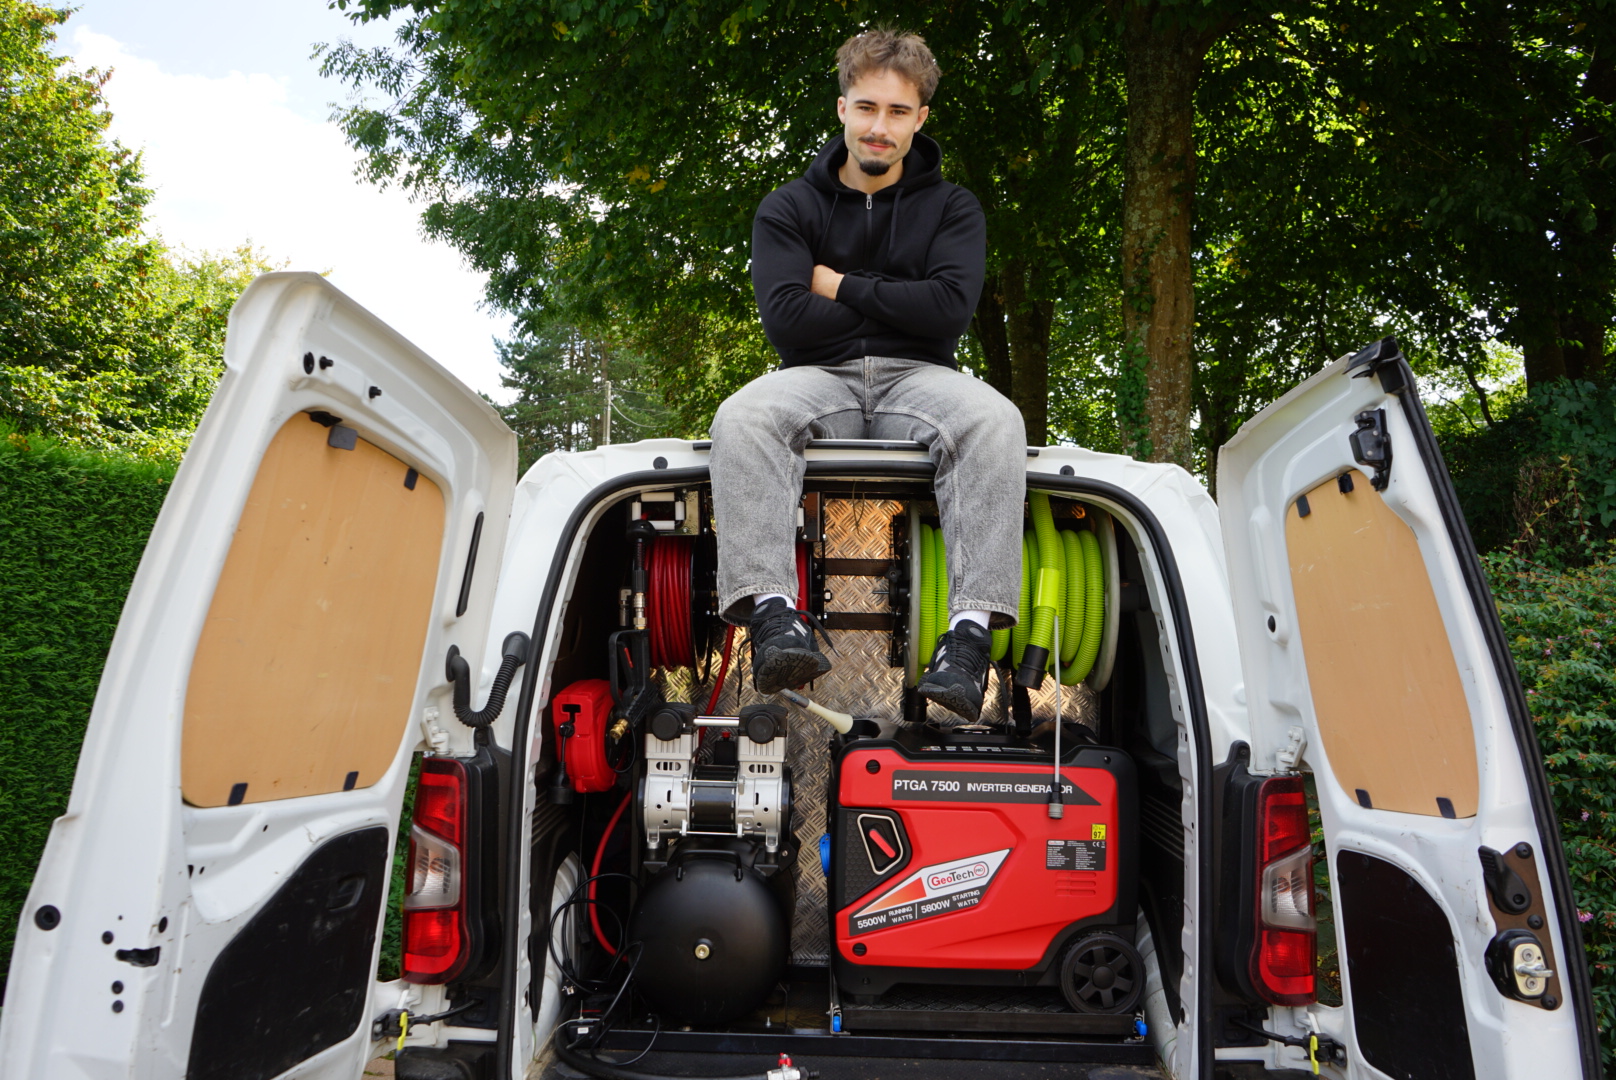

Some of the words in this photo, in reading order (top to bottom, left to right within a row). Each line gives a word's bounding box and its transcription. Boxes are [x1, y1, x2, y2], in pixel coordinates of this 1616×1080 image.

[894, 779, 928, 792] PTGA
[931, 780, 960, 792] 7500
[967, 782, 1012, 793] INVERTER
[1014, 784, 1073, 794] GENERAOR
[1093, 831, 1101, 839] 97
[931, 870, 974, 886] GeoTech
[952, 889, 981, 901] STARTING
[921, 900, 950, 914] 5800W
[957, 898, 979, 908] WATTS
[888, 906, 913, 917] RUNNING
[857, 914, 887, 929] 5500W
[892, 914, 914, 924] WATTS
